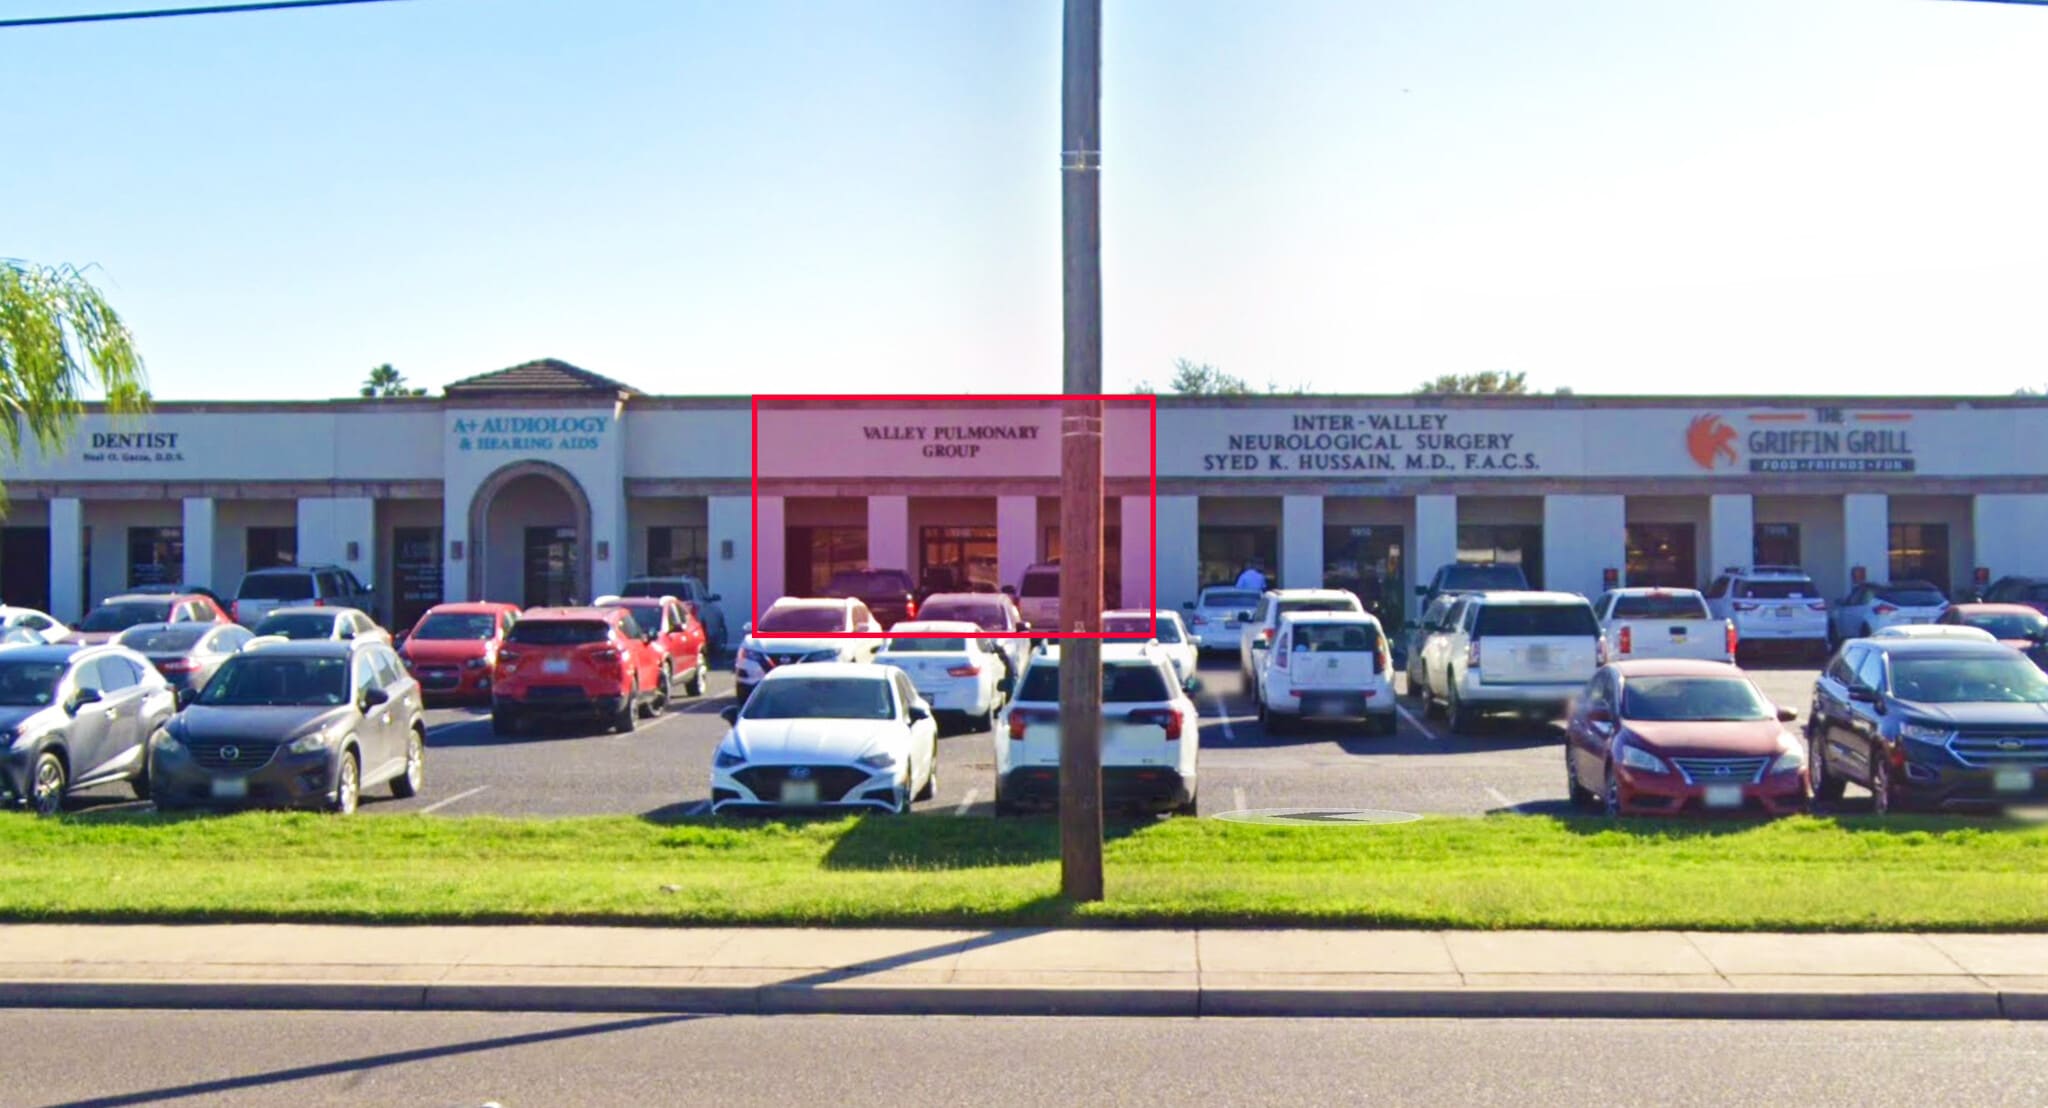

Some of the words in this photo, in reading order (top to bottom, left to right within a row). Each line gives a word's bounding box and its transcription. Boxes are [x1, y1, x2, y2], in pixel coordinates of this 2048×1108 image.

[1293, 414, 1448, 431] INTER-VALLEY
[1814, 407, 1844, 423] THE
[481, 416, 608, 433] AUDIOLOGY
[92, 432, 178, 448] DENTIST
[863, 426, 926, 440] VALLEY
[933, 426, 1040, 440] PULMONARY
[459, 437, 471, 450] &
[477, 437, 553, 450] HEARING
[559, 437, 600, 450] AIDS
[1228, 433, 1402, 450] NEUROLOGICAL
[1417, 433, 1514, 450] SURGERY
[1749, 430, 1840, 454] GRIFFIN
[1847, 430, 1913, 454] GRILL
[922, 444, 980, 458] GROUP
[1203, 453, 1259, 470] SYED
[1268, 453, 1289, 470] K.
[1299, 453, 1395, 471] HUSSAIN,
[1405, 453, 1455, 471] M.D.,
[1464, 453, 1540, 470] F.A.C.S.
